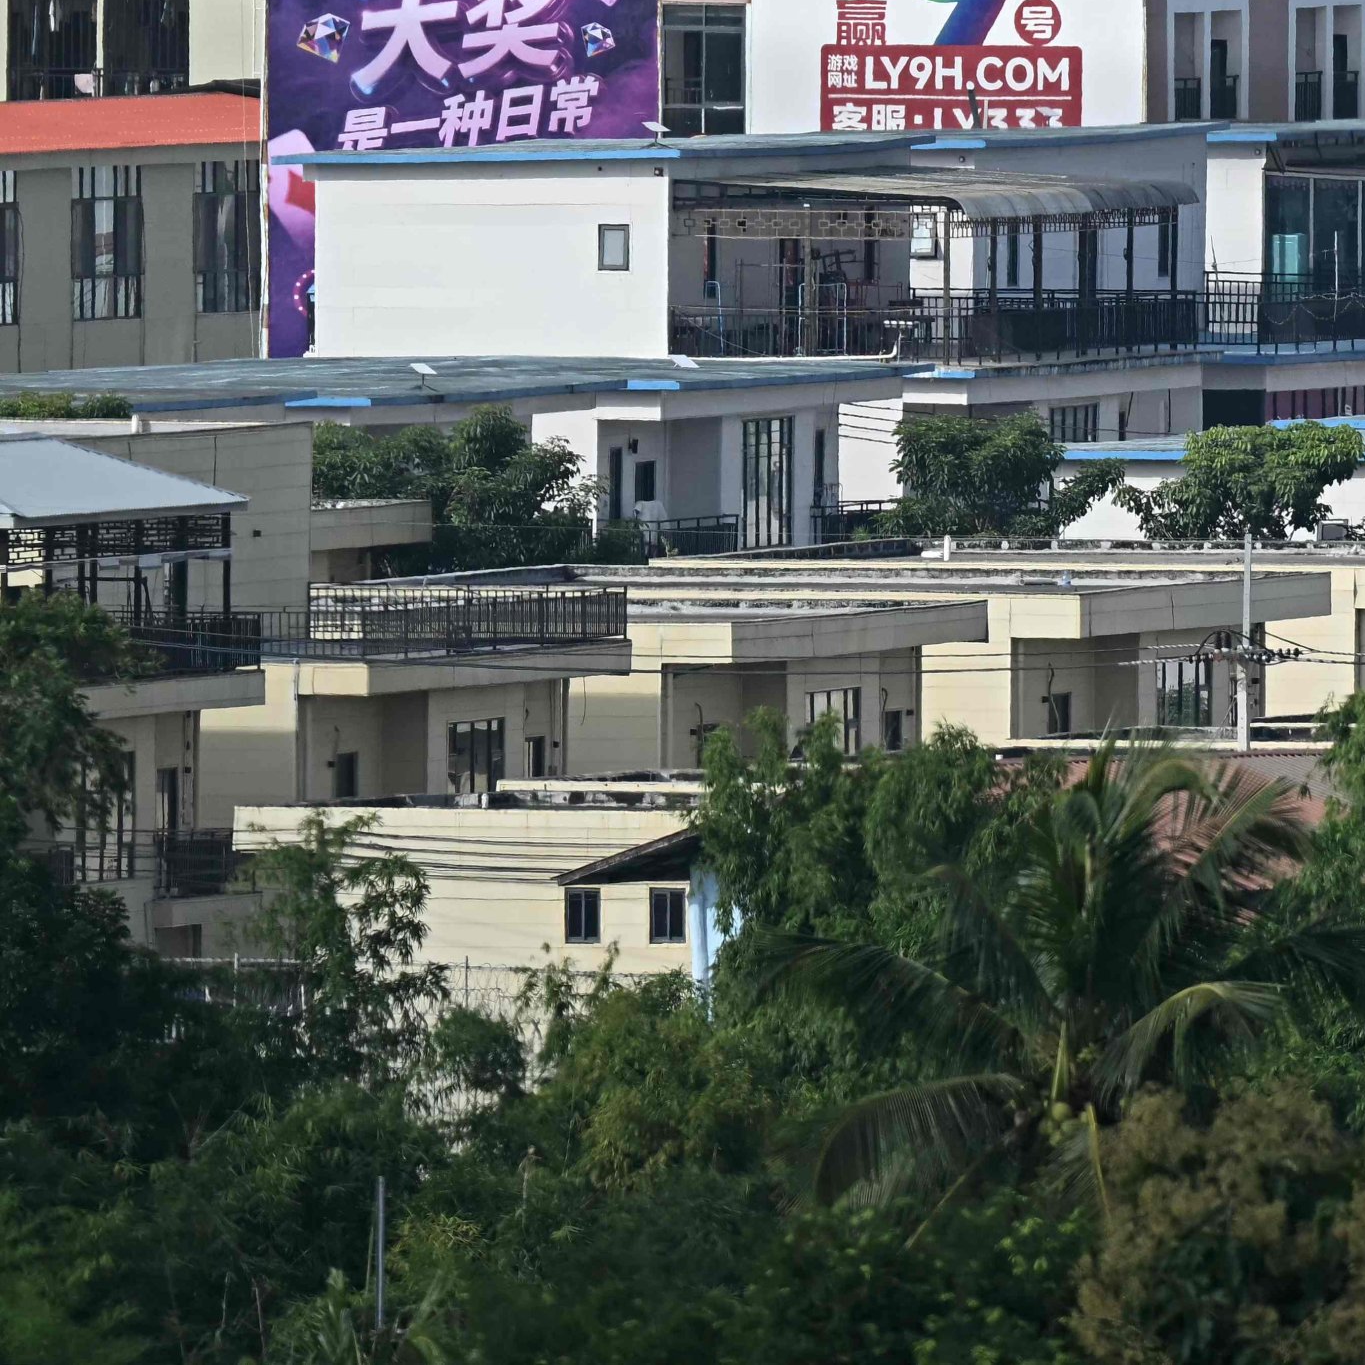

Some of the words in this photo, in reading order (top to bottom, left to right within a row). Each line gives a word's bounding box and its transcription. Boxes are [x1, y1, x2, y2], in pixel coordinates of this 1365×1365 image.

[1020, 6, 1055, 41] 号
[827, 55, 858, 71] 游戏
[827, 72, 858, 88] 网址
[865, 56, 1070, 91] LY9H.COM
[337, 75, 599, 151] 是一种日常
